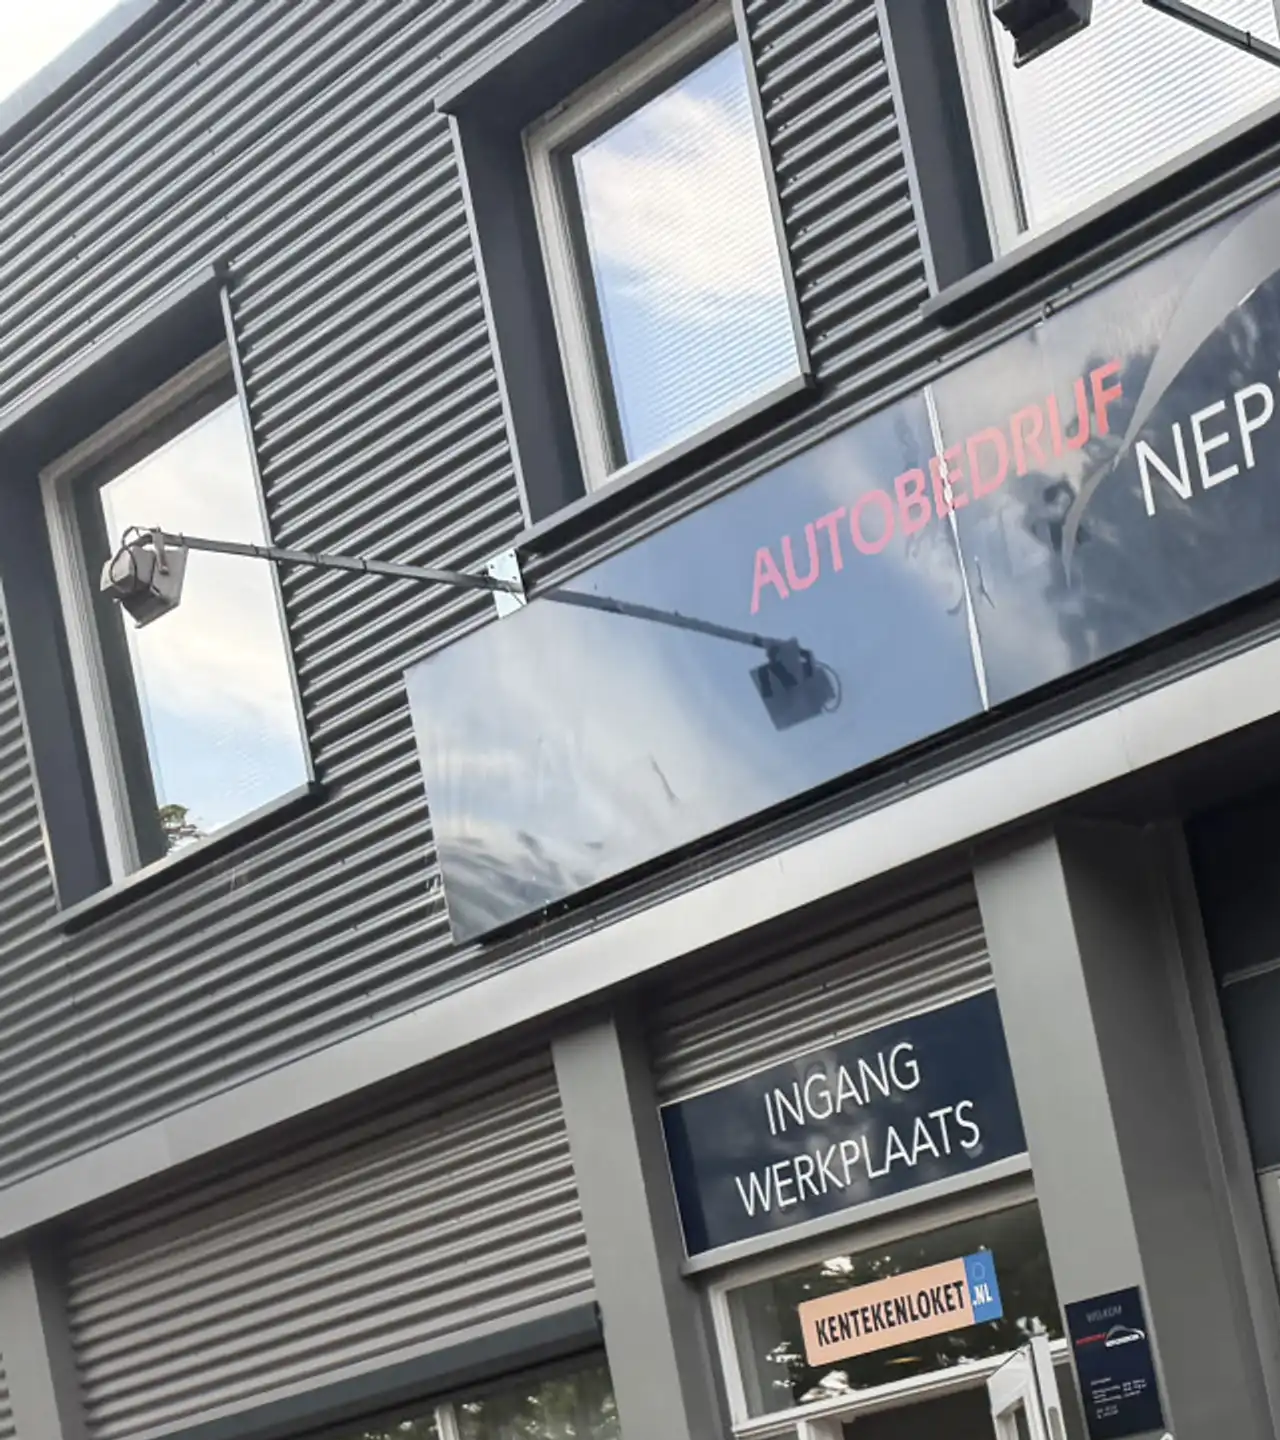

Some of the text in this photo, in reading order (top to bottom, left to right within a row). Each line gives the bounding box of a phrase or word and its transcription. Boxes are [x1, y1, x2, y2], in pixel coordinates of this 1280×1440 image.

[749, 359, 1125, 614] AUTOBEDRIJF
[763, 1042, 921, 1136] INGANG
[735, 1100, 981, 1216] WERKPLAATS
